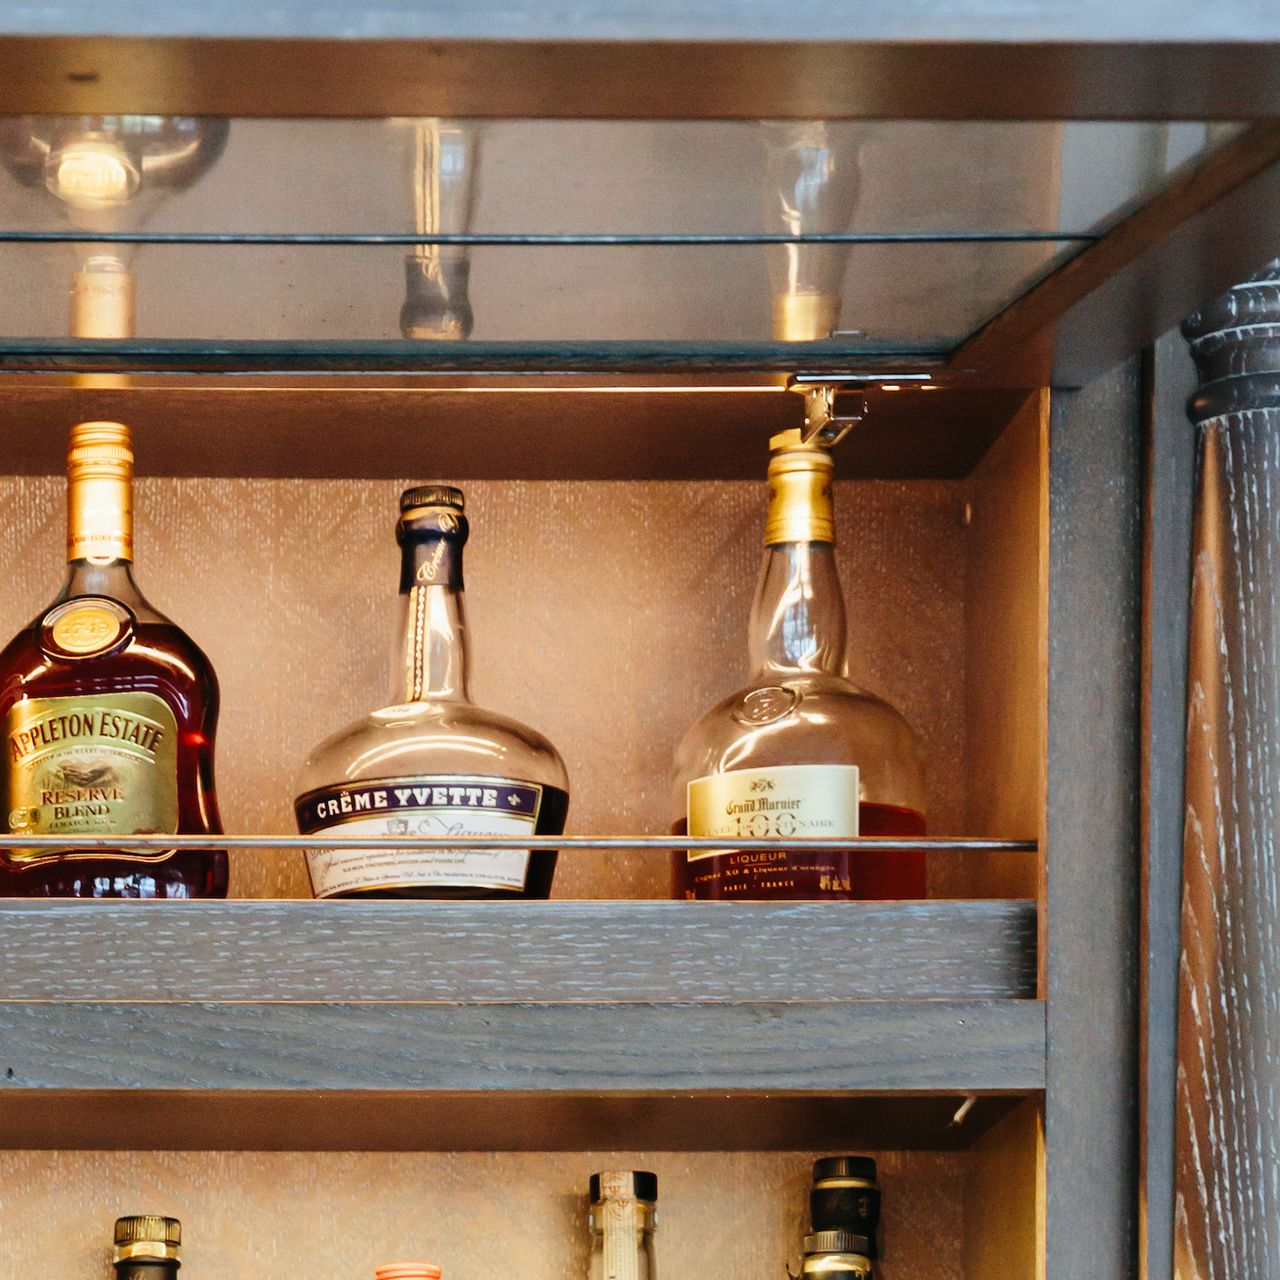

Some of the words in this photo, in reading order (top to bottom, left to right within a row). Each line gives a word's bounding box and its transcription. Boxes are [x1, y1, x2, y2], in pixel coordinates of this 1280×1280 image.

[10, 712, 96, 764] APPLETON
[98, 711, 166, 755] ESTATE
[40, 787, 125, 807] RESERVE
[393, 787, 498, 807] YVETTE
[725, 799, 757, 816] Grand
[757, 797, 802, 812] Marnier
[53, 805, 113, 821] BLEND
[729, 851, 787, 865] LIQUEUR
[725, 868, 739, 878] XO
[753, 864, 788, 874] Liqueur
